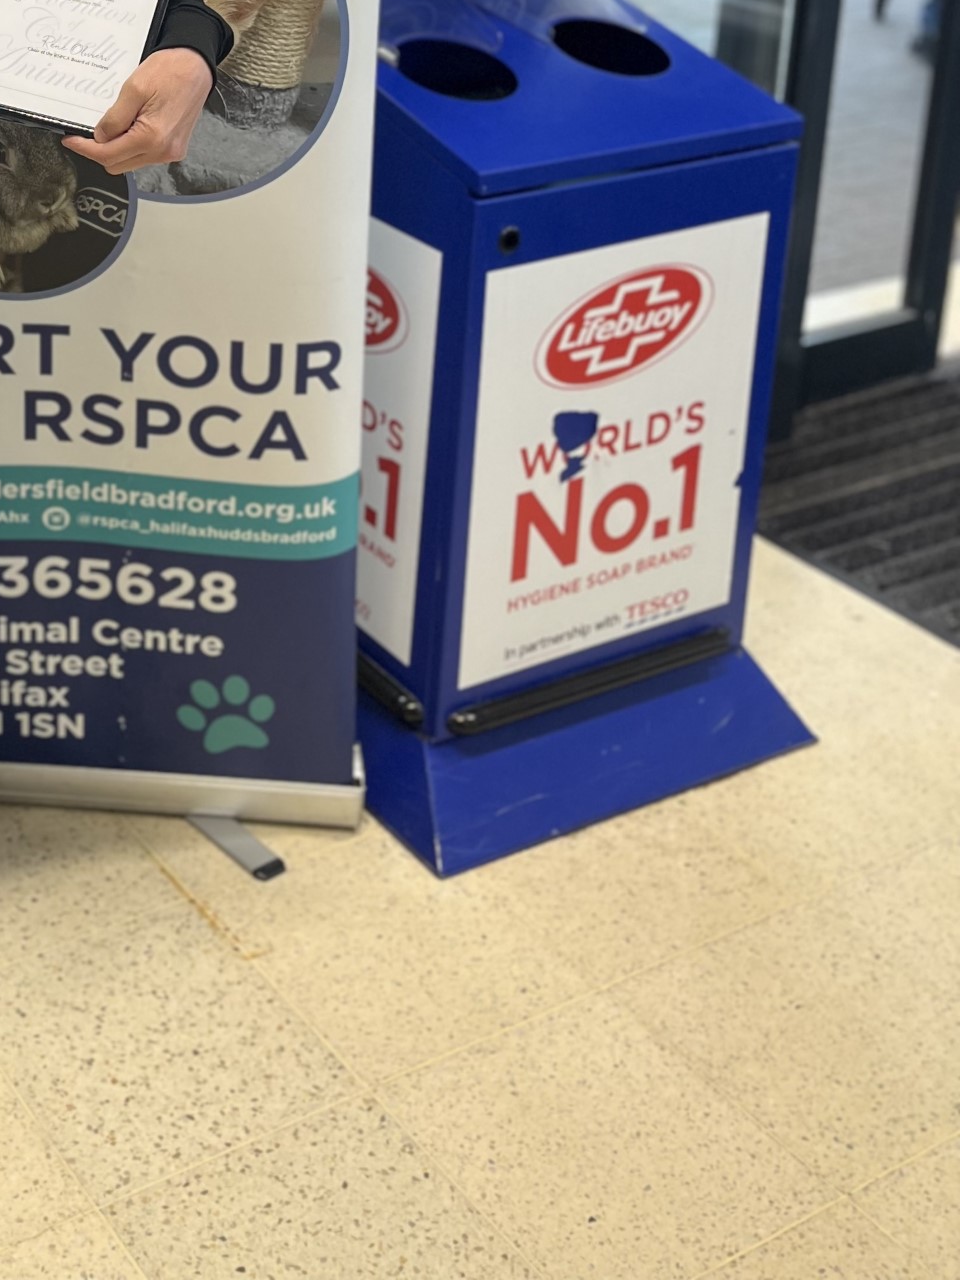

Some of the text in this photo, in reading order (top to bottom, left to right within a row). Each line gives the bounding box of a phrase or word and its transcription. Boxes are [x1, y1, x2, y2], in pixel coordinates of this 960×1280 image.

[557, 300, 692, 351] Lifebuoy
[100, 327, 343, 395] YOUR
[23, 389, 309, 462] RSPCA
[510, 443, 702, 583] No.1
[507, 576, 581, 614] HYGIENE
[586, 563, 632, 589] SOAP
[91, 618, 224, 658] Centre
[518, 623, 591, 660] partnership
[625, 588, 690, 620] TESCO
[5, 649, 125, 680] Street
[15, 710, 86, 740] 1SN
